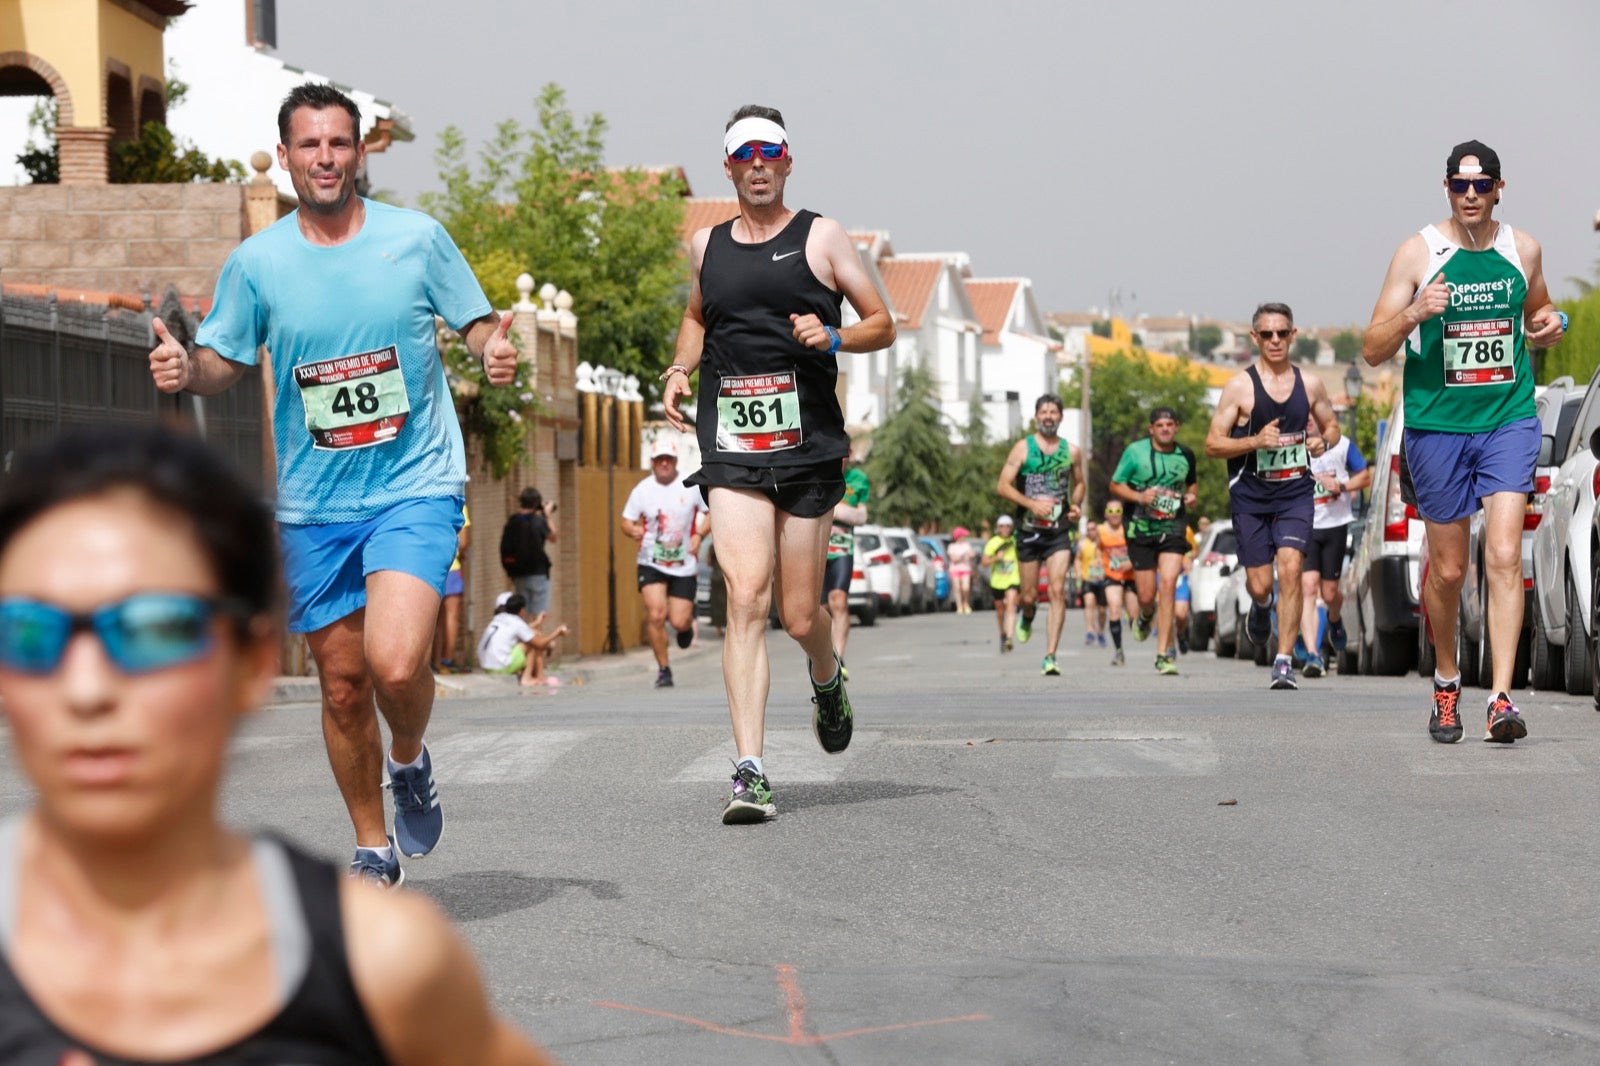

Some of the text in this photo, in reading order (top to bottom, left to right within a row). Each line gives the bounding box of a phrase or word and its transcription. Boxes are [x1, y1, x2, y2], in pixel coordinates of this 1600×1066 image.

[1450, 292, 1494, 307] DELFOS
[318, 363, 334, 375] GRAN
[334, 357, 361, 373] PREMIO
[361, 354, 371, 366] DE
[370, 350, 392, 363] FONDO
[1457, 339, 1504, 364] 786
[730, 379, 744, 388] GRAN
[744, 378, 764, 388] PREMIO
[766, 376, 773, 386] DE
[774, 374, 790, 385] FONDO
[331, 382, 380, 418] 48
[730, 398, 784, 428] 361
[1266, 448, 1298, 466] 711
